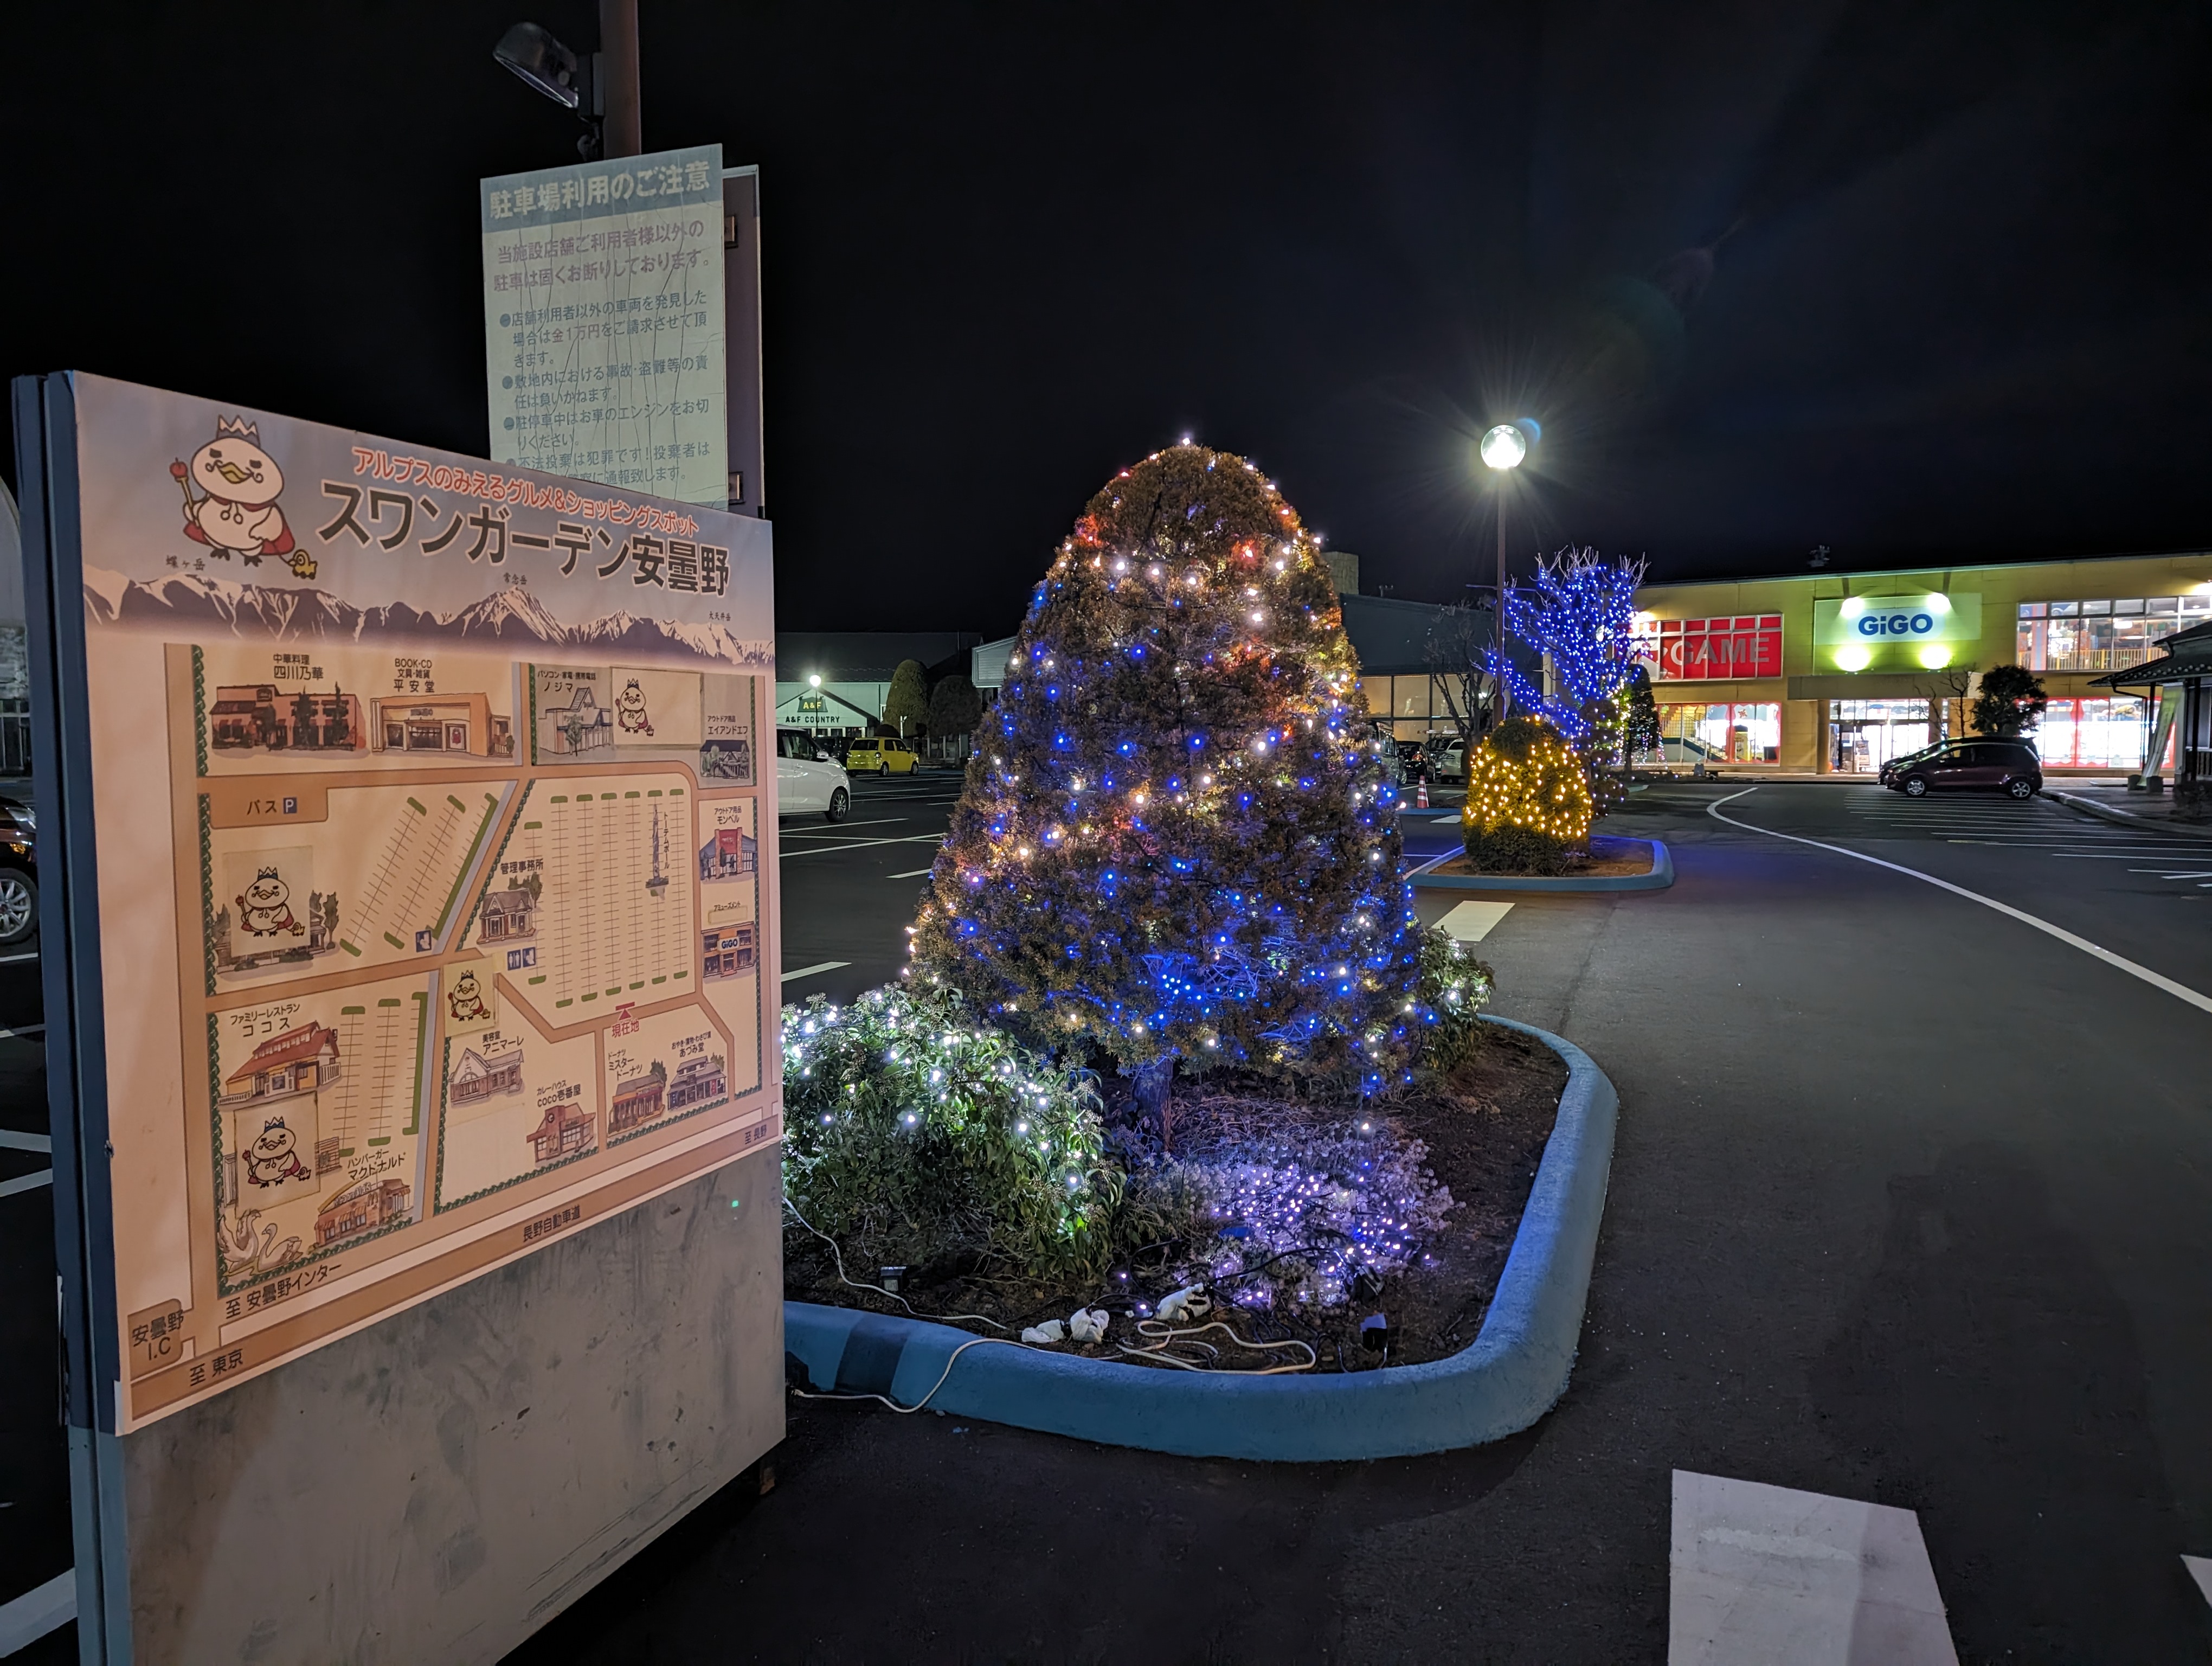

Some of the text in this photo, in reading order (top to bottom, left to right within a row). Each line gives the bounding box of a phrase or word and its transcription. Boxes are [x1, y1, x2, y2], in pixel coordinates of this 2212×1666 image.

[490, 161, 710, 219] 駐車場利用のご注意
[498, 219, 704, 264] 当施設店舗ご利用者様以外の
[494, 249, 709, 292] 駐車は固くお断りしております。
[514, 352, 555, 368] きます。
[515, 387, 618, 410] 任は負いかねます。
[517, 433, 580, 451] りください。
[350, 446, 699, 537] アルプスのみえるグルメ&ショッピングスポット
[317, 479, 730, 598] スワンガーデン安曇野
[1858, 613, 1933, 636] GiGO
[273, 654, 310, 665] 中華料理
[1669, 637, 1771, 667] GAME
[274, 666, 324, 680] 四川乃華
[544, 682, 573, 693] ノジマ
[708, 726, 748, 734] エイアンドエフ
[247, 799, 277, 816] バス
[714, 806, 742, 815] アウトドア用品
[717, 815, 740, 824] モンベル
[500, 858, 544, 874] 管理事務所
[722, 938, 738, 949] GiGO
[230, 1003, 300, 1025] ファミリーレストラン
[243, 1018, 290, 1037] ココス
[483, 1031, 500, 1043] 美容室
[612, 1019, 640, 1038] 現在地
[483, 1036, 524, 1055] アニマーレ
[608, 1049, 626, 1060] ドーナツ
[680, 1042, 704, 1058] あづみ堂
[608, 1058, 634, 1071] ミスター
[616, 1064, 643, 1081] ドーナツ
[537, 1080, 567, 1095] カレーハウス
[745, 1125, 767, 1145] 至 長野
[348, 1149, 390, 1169] ハンバーガー
[348, 1151, 407, 1181] マクドナルド
[523, 1205, 581, 1243] 長野自動車道
[226, 1263, 342, 1319] 至 安曇野インター
[132, 1310, 184, 1347] 安曇野
[189, 1348, 243, 1387] 至 東京
